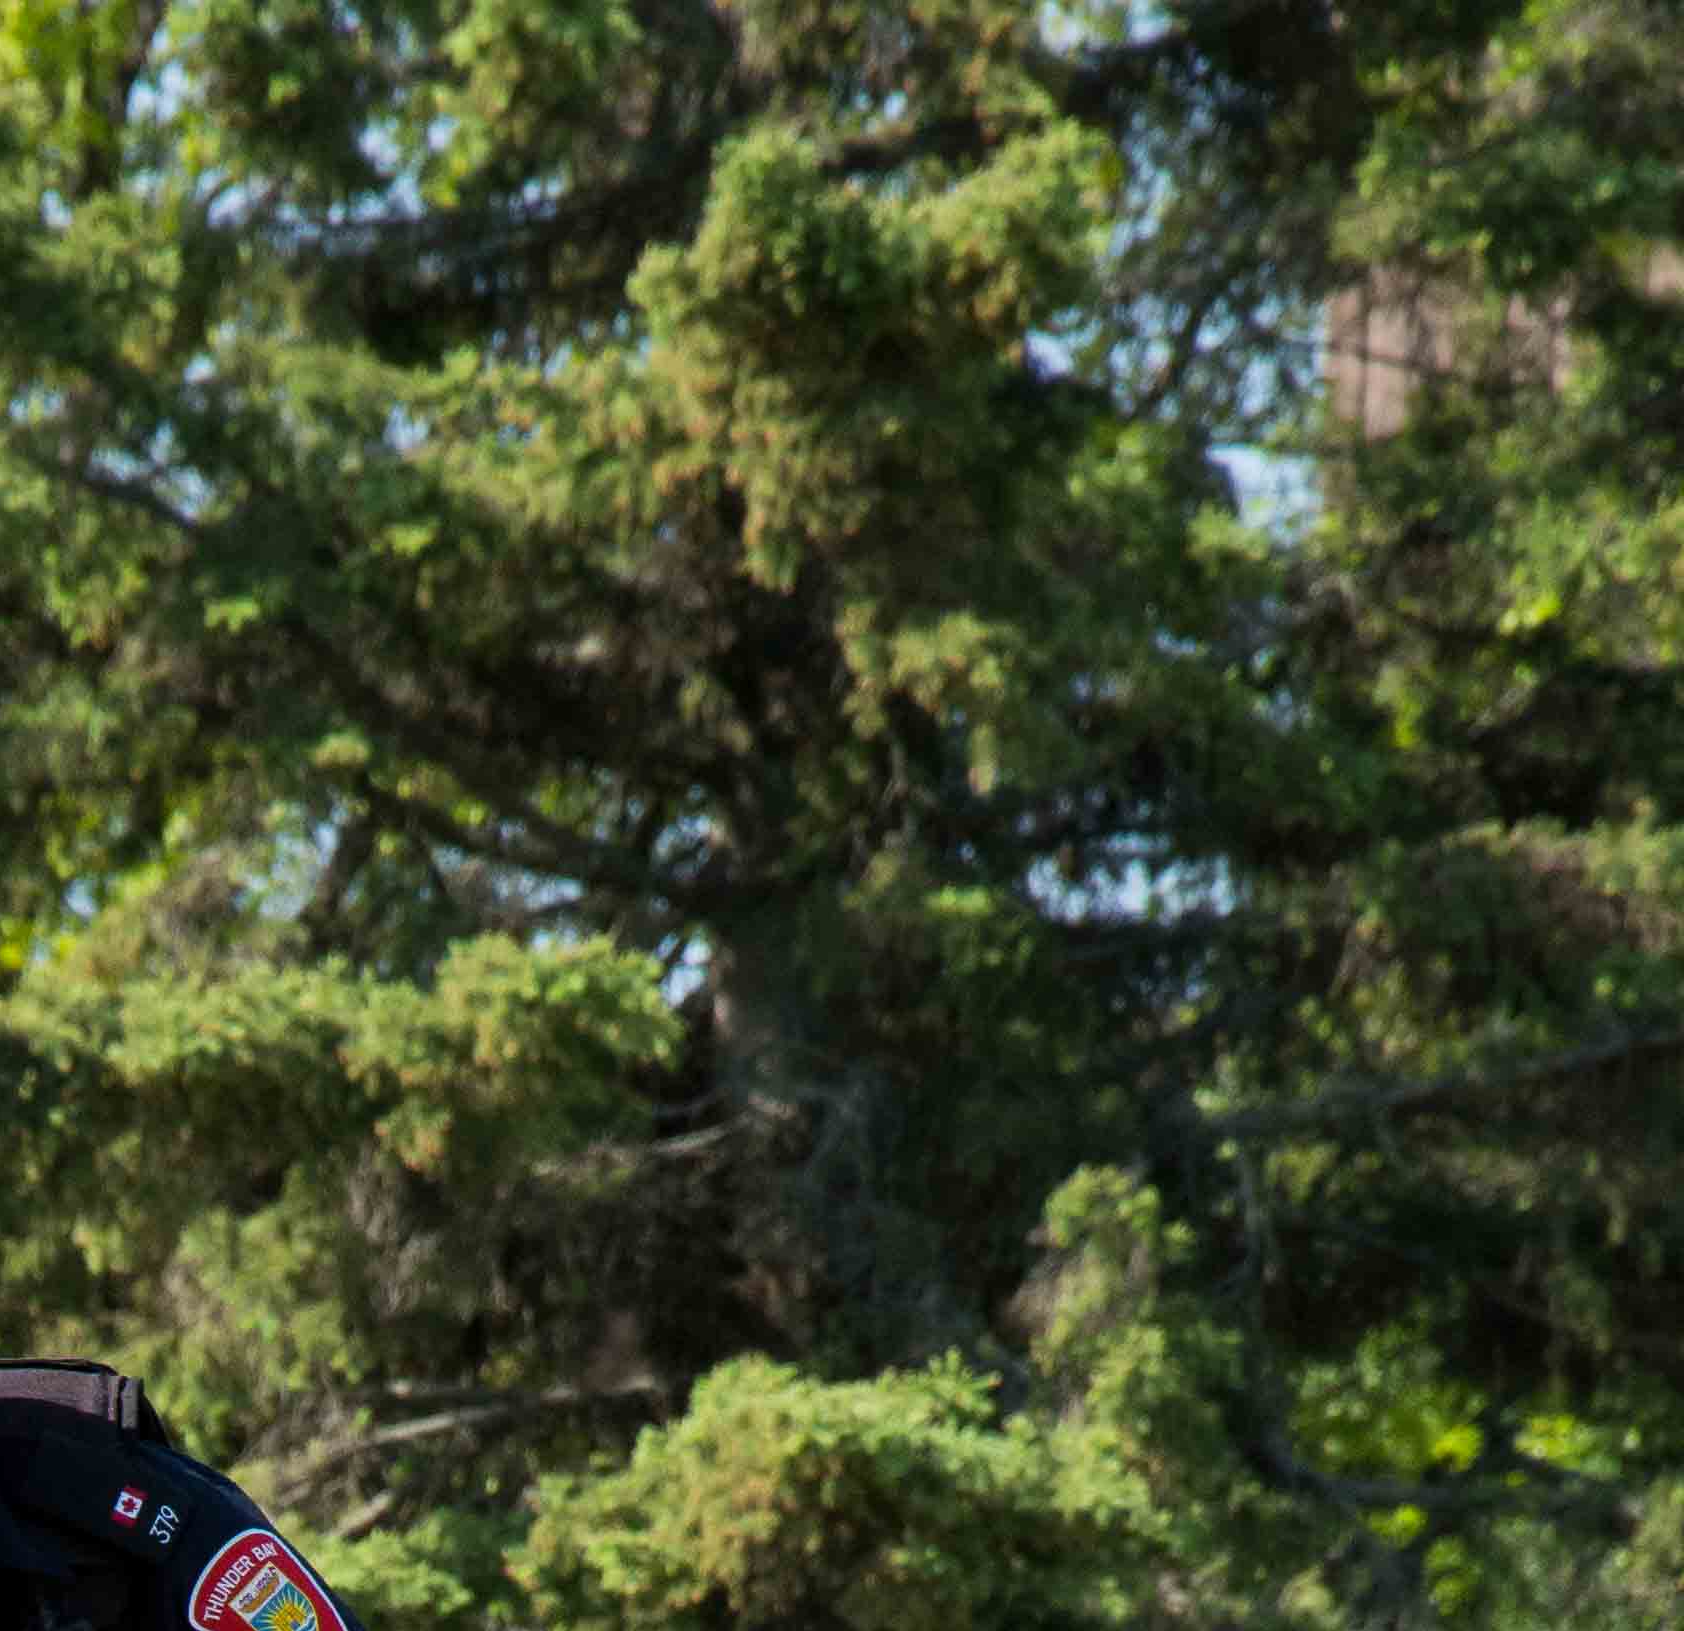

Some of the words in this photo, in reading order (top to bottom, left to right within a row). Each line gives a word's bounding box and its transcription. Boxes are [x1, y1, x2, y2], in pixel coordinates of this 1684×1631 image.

[148, 1504, 180, 1544] 379
[203, 1555, 254, 1623] THUNDER
[251, 1541, 279, 1563] BAY
